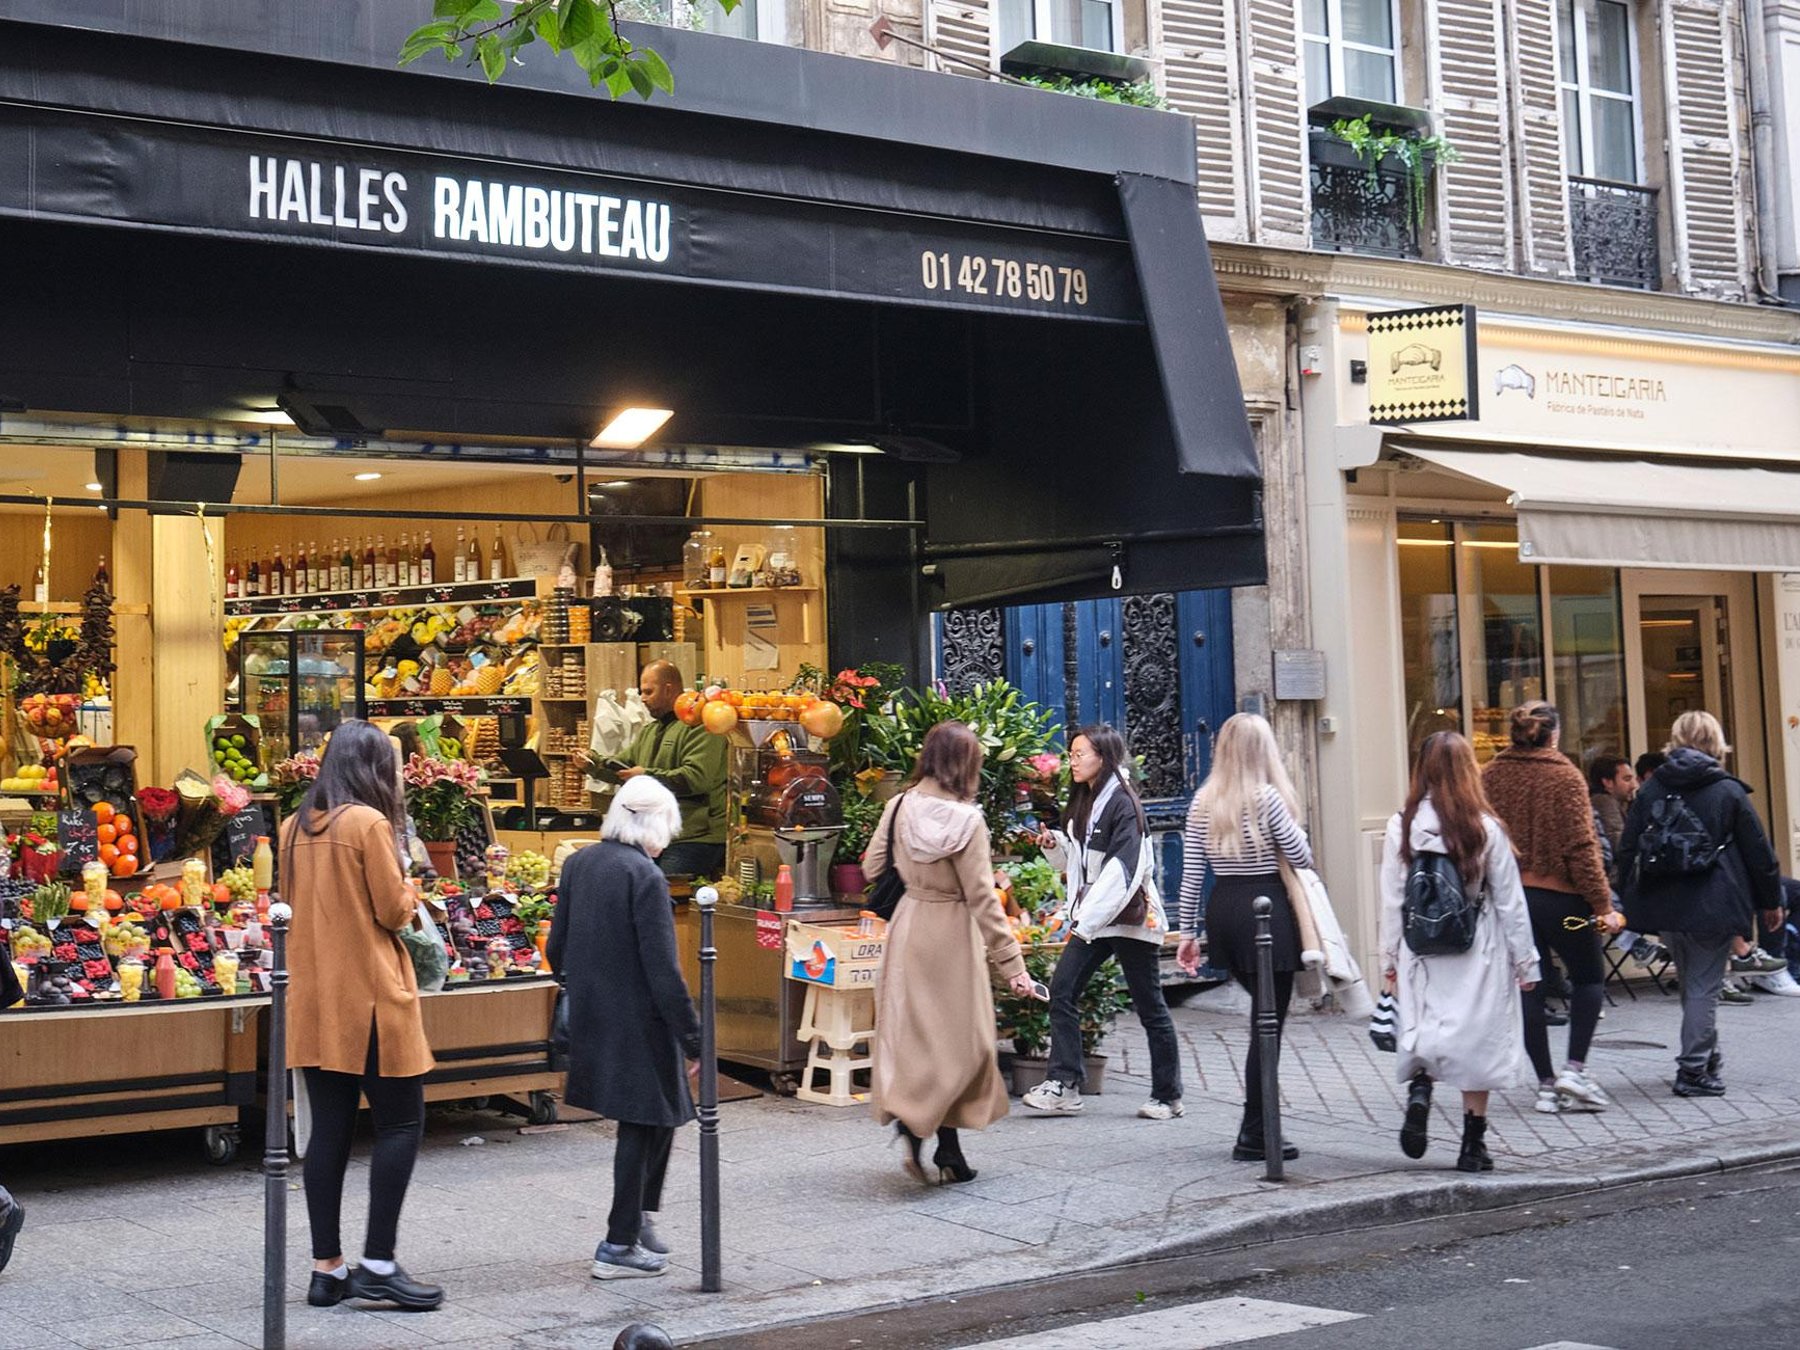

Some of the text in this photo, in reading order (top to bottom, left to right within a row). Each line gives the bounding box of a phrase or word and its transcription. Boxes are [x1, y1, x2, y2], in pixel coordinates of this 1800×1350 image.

[249, 155, 670, 264] HALLES RAMBUTEAU
[921, 250, 1089, 305] 01 42 78 50 79
[1546, 371, 1667, 402] MANTEIGARIA
